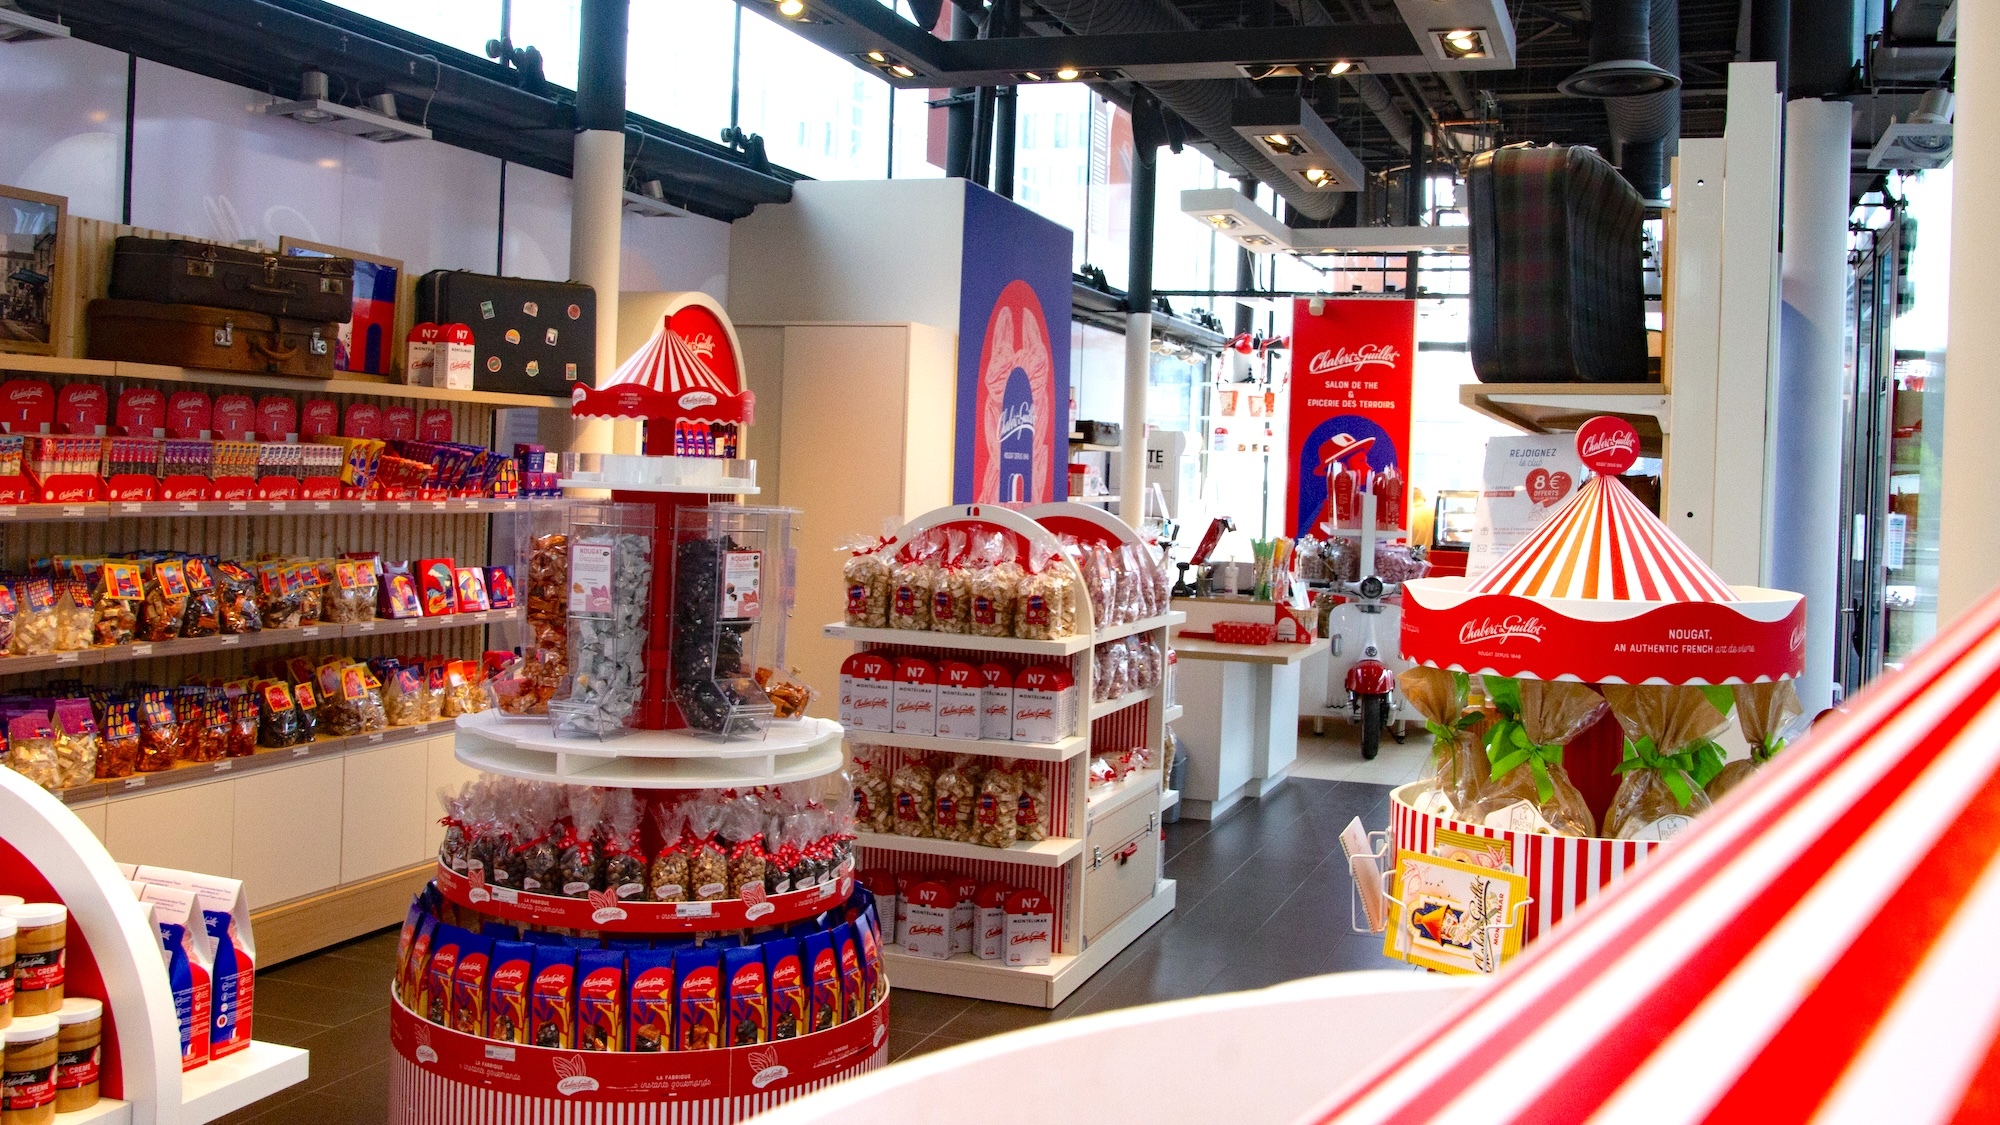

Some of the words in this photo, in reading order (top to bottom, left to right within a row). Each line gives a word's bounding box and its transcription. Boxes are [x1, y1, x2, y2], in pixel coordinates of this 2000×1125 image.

[422, 329, 438, 338] N7
[457, 330, 468, 340] N7
[1325, 381, 1349, 389] SALON
[1352, 381, 1361, 389] DE
[1364, 382, 1378, 390] THE
[1307, 399, 1339, 408] EPICERIE
[1342, 400, 1357, 408] DES
[1360, 400, 1395, 409] TERROIRS
[1147, 450, 1164, 463] TE
[1510, 449, 1556, 458] REJOIGNEZ
[1534, 475, 1545, 489] 8
[1614, 644, 1626, 652] AN
[1630, 644, 1678, 653] AUTHENTIC
[1682, 645, 1713, 653] FRENCH
[864, 664, 881, 674] N7
[907, 667, 925, 678] N7
[950, 670, 968, 681] N7
[1028, 674, 1046, 684] N7
[920, 890, 937, 901] N7
[960, 886, 975, 896] N7
[1022, 898, 1040, 908] N7
[1494, 893, 1505, 945] MONELIMAR
